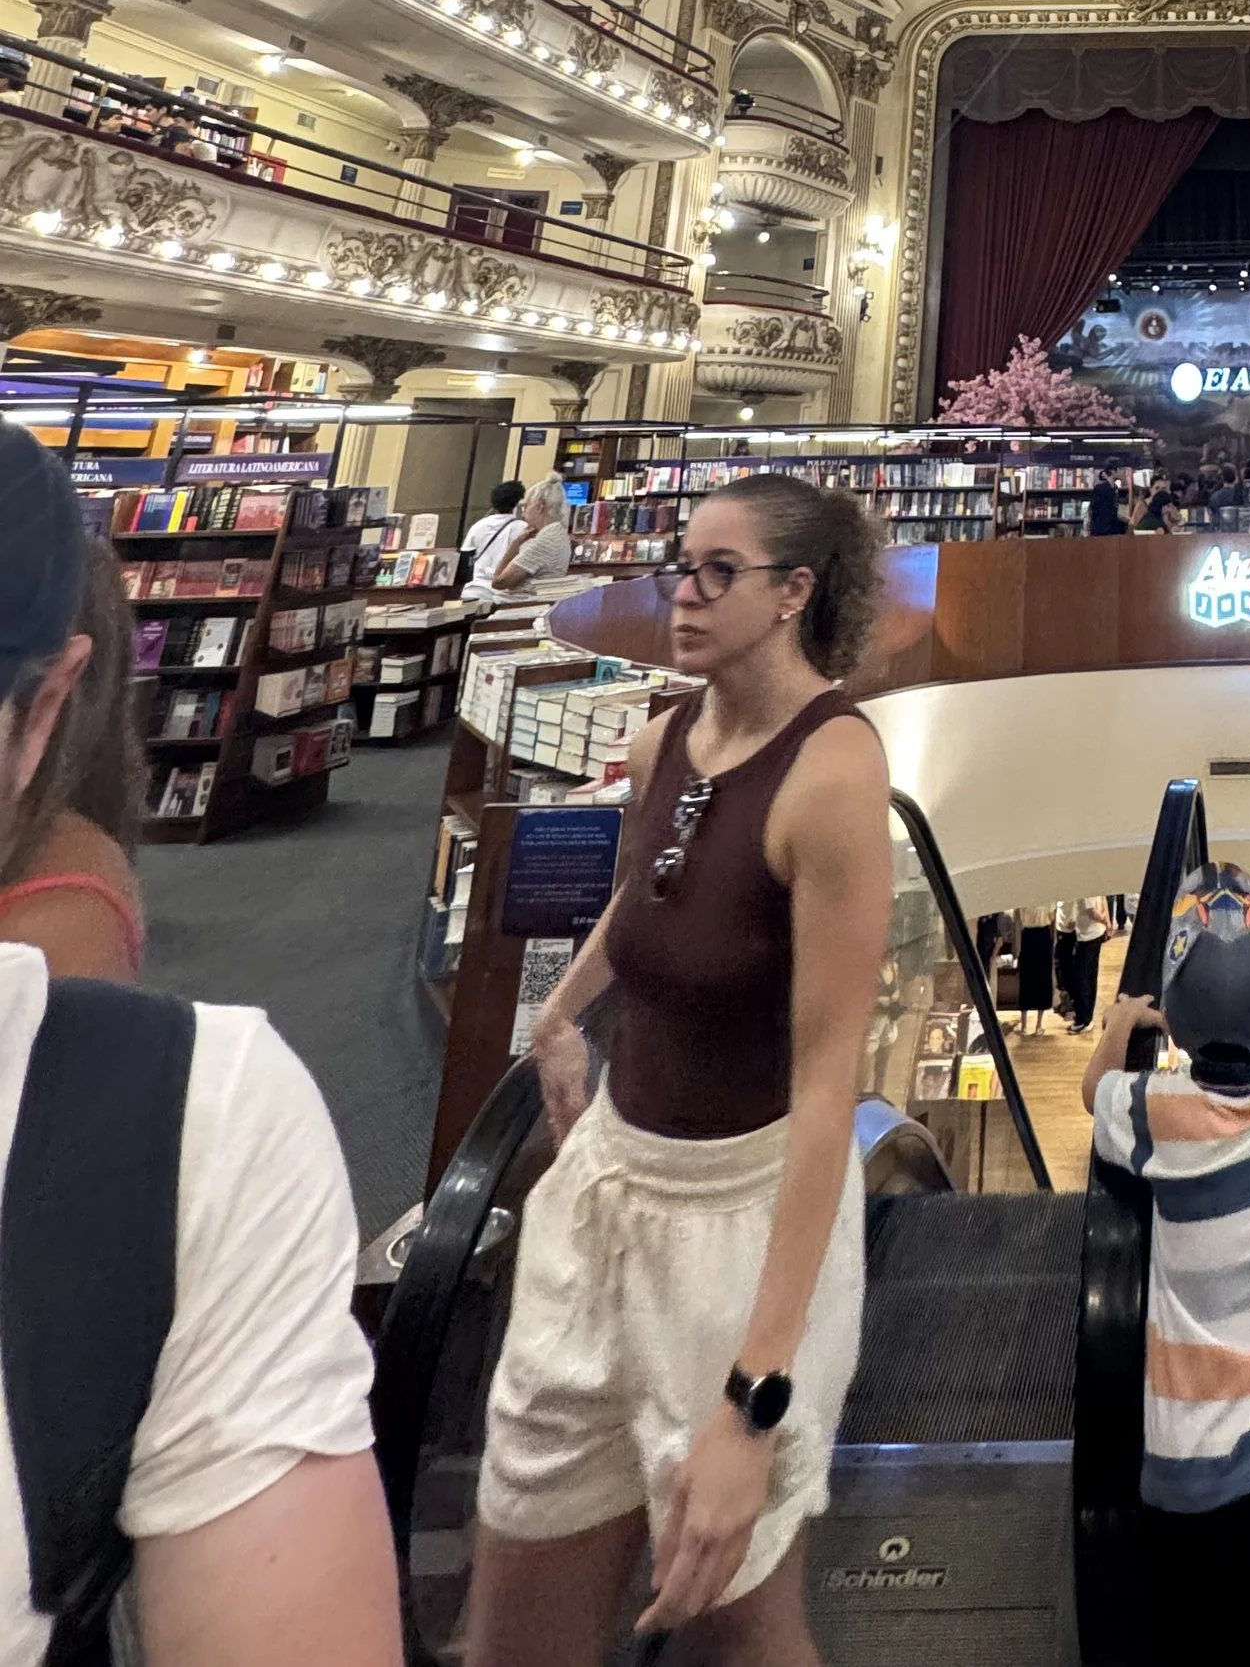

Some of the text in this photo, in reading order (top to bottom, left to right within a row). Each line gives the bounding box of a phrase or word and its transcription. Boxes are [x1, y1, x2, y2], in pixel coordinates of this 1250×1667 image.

[1203, 368, 1230, 391] El
[72, 461, 99, 471] TURA
[188, 461, 320, 474] LITERATURA LATINOAMERICANA
[71, 473, 113, 482] ERICANA
[824, 1567, 945, 1589] Schindler
